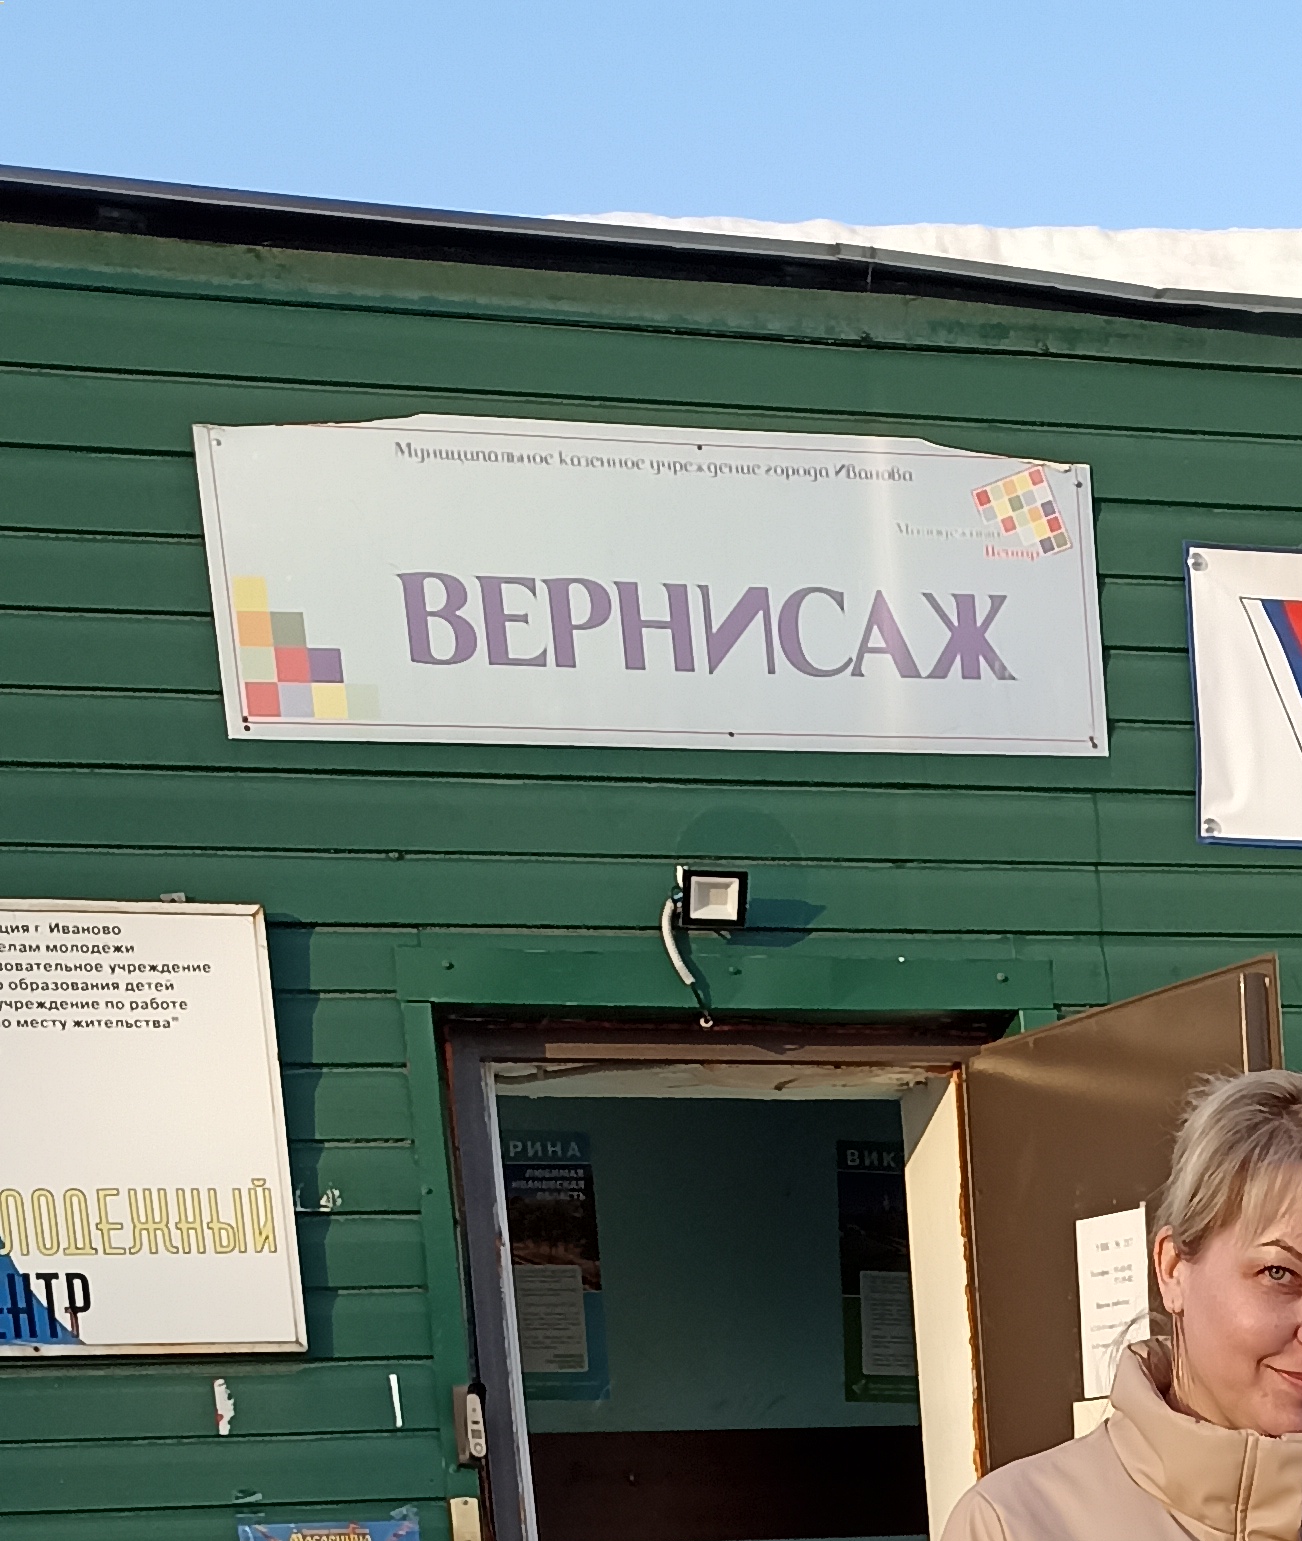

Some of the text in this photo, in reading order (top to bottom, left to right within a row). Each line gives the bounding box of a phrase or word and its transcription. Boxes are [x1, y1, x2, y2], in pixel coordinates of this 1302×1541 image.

[558, 450, 646, 471] казенное
[764, 463, 830, 483] города
[395, 569, 1018, 683] ВЕРНИСАЖ
[0, 923, 30, 935] ция
[48, 922, 122, 936] Иваново
[45, 944, 135, 955] молодежи
[109, 962, 212, 975] учреждение
[8, 977, 175, 993] образования детей
[105, 999, 125, 1010] по
[129, 997, 188, 1011] работе
[16, 1018, 67, 1031] месту
[508, 1140, 582, 1158] РИНА
[846, 1149, 896, 1168] ВИК
